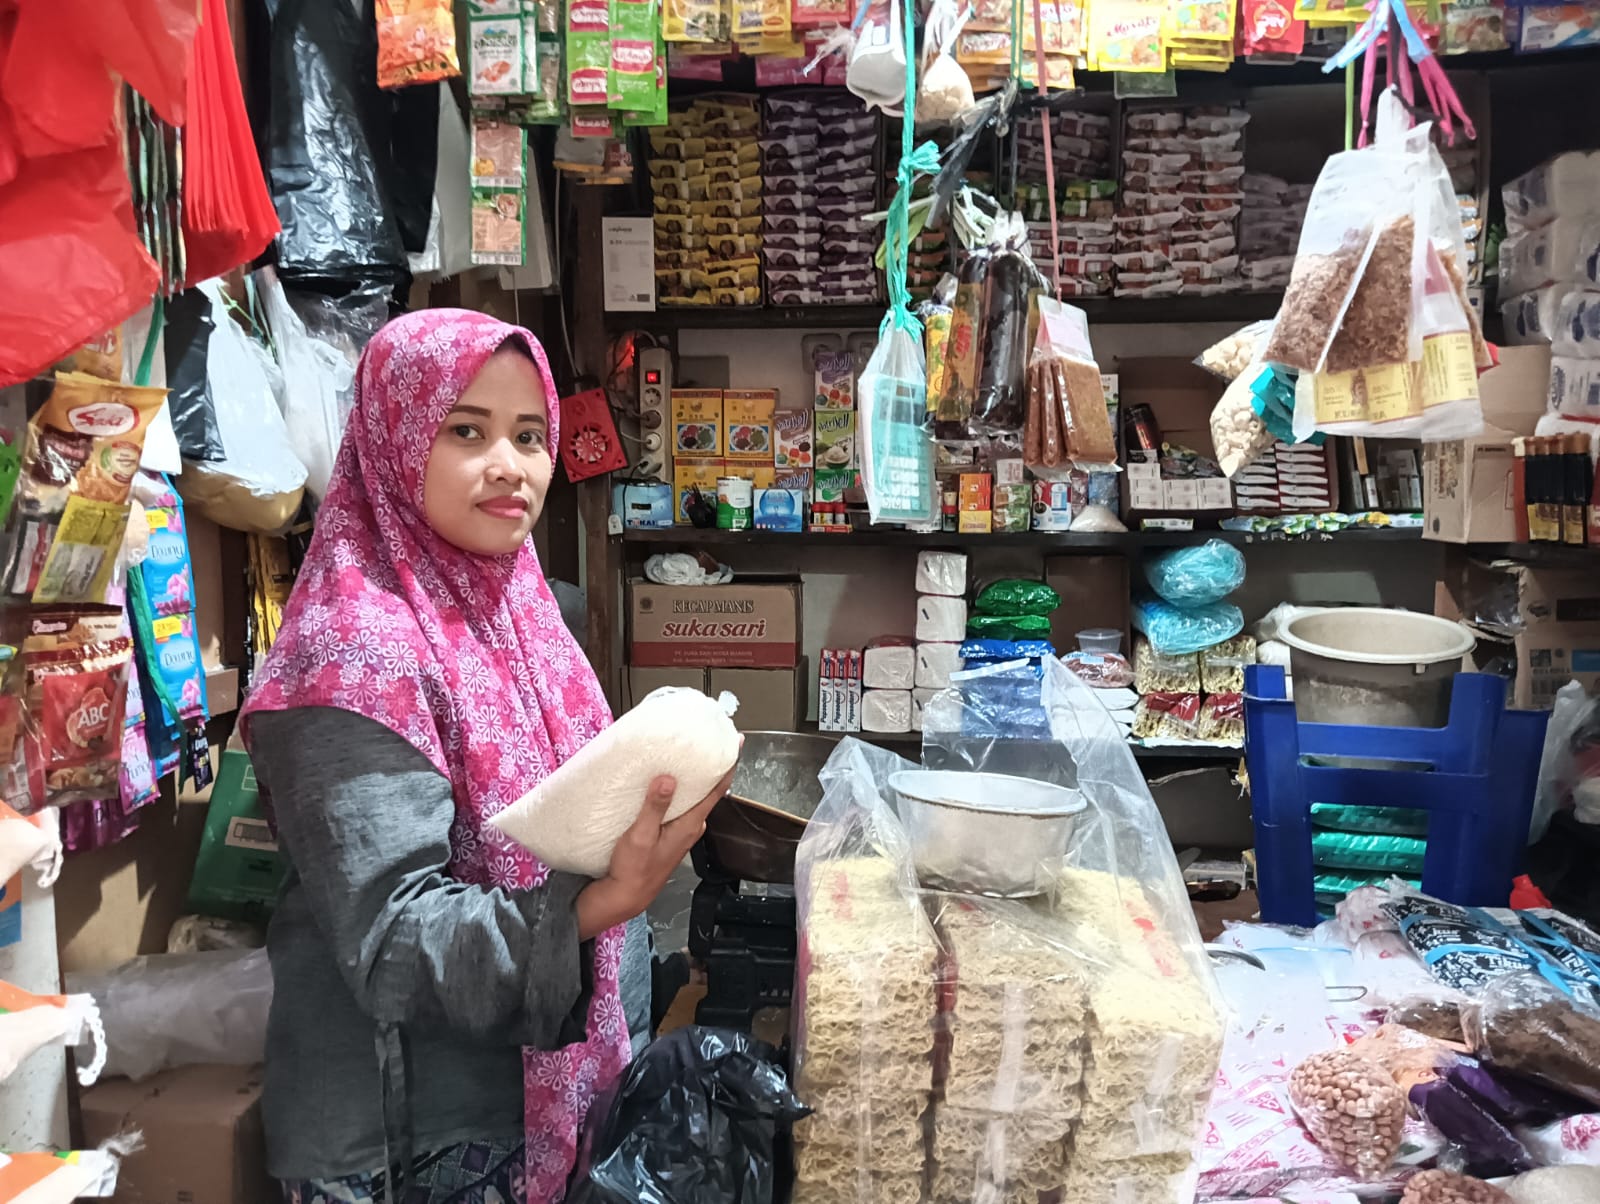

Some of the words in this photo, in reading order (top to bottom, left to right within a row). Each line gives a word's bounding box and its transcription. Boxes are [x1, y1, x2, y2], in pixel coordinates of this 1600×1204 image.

[672, 600, 713, 614] KECAP
[712, 600, 754, 614] MANIS
[662, 618, 719, 638] suka
[719, 619, 765, 637] sari
[77, 703, 109, 728] ABC
